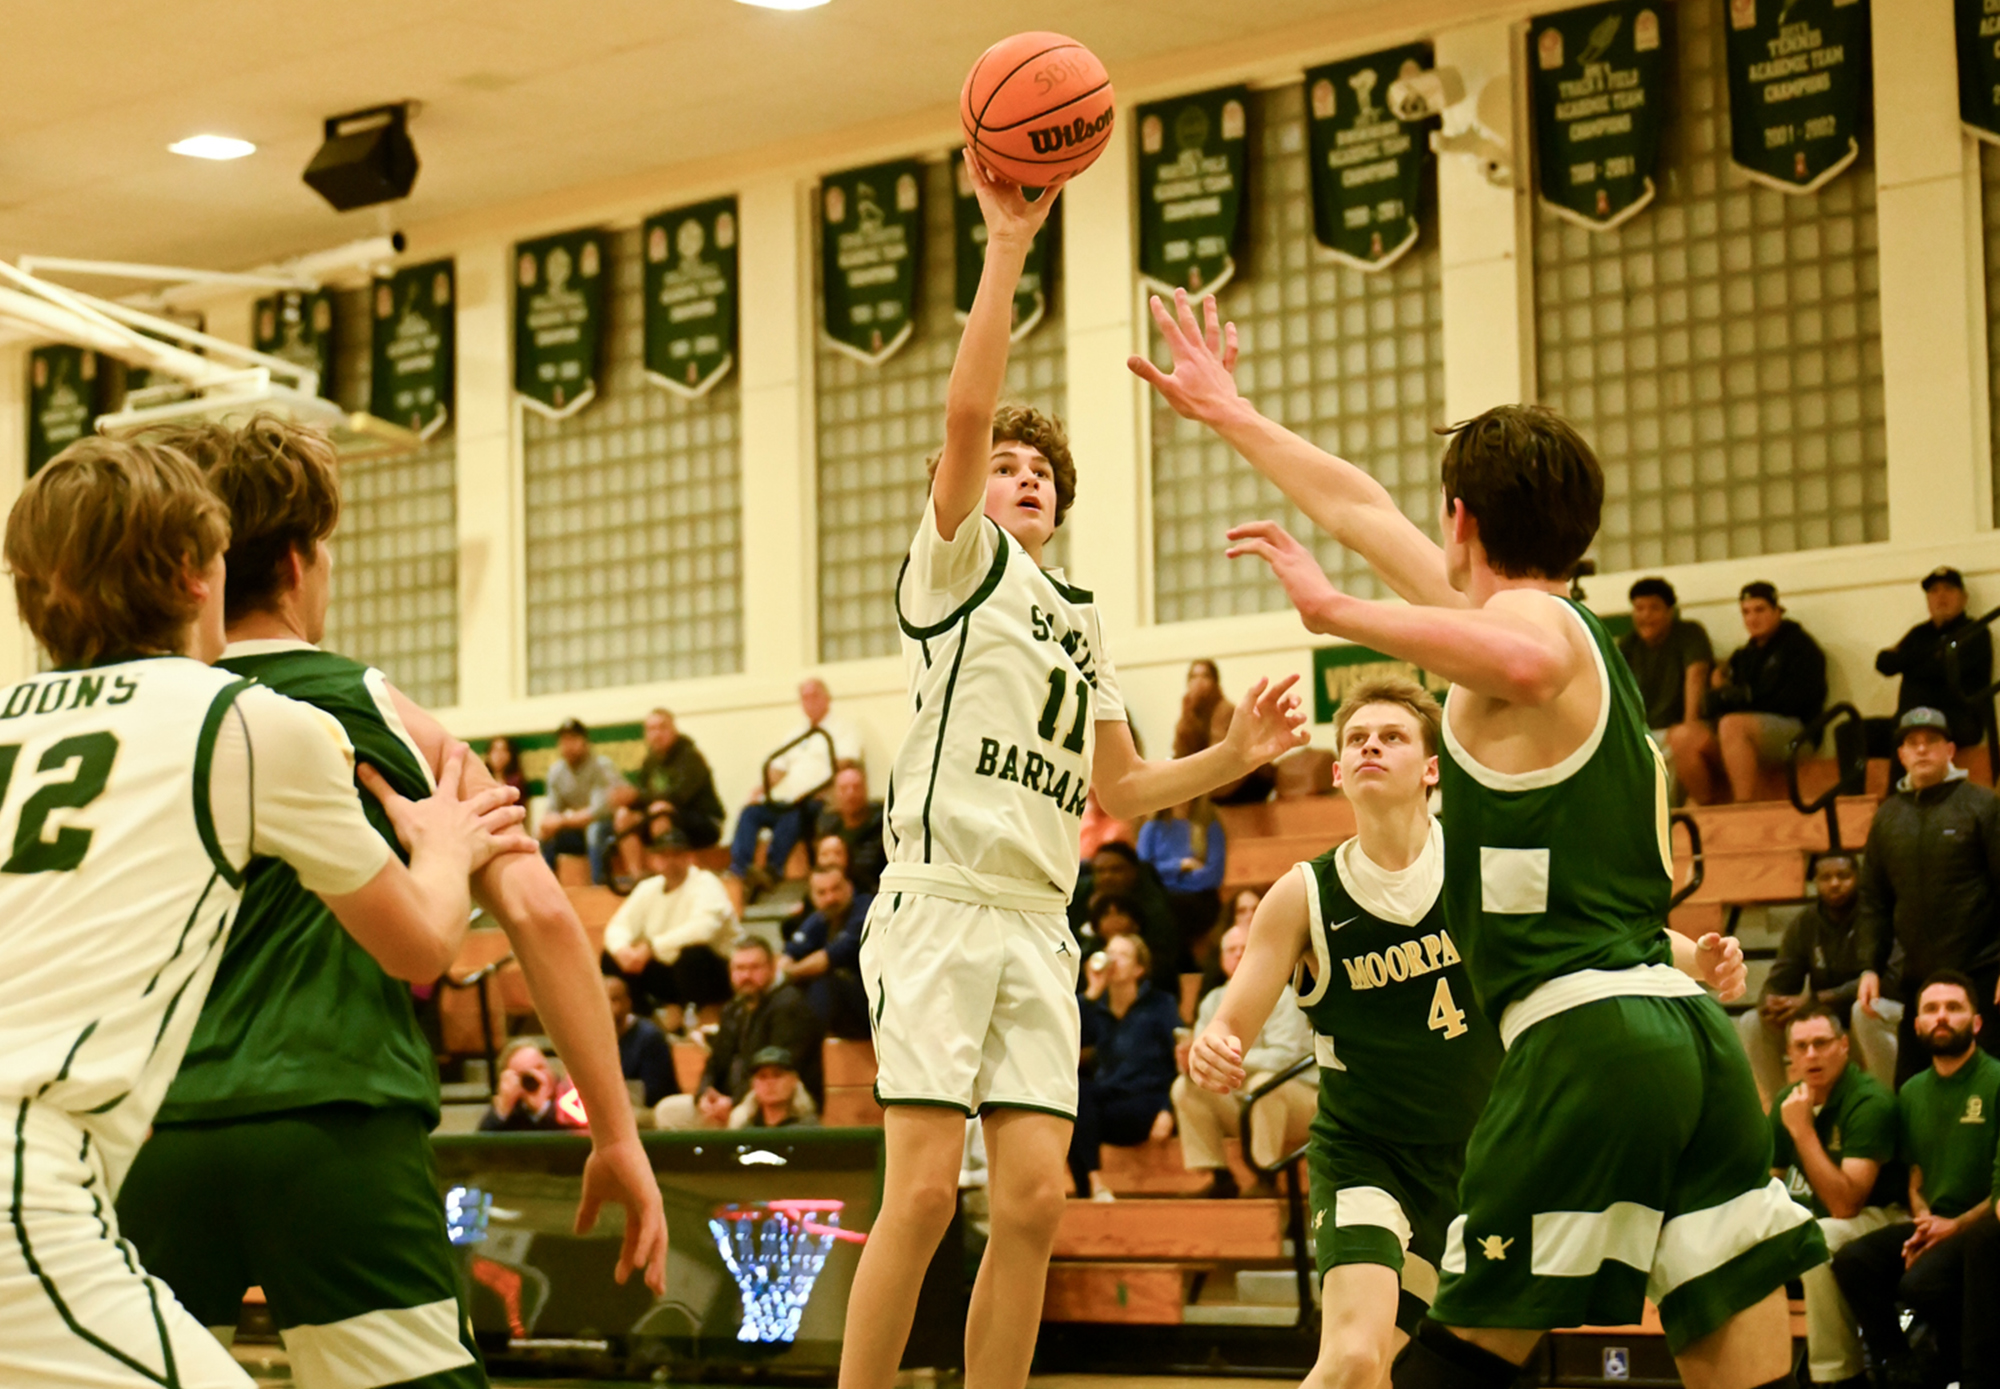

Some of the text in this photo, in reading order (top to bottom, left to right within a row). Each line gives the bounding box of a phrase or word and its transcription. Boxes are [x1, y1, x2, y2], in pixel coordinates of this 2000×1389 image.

[1027, 105, 1115, 155] Wilson
[0, 674, 138, 721] DONS
[1037, 666, 1089, 755] 11
[1342, 929, 1462, 990] MOORPA
[1427, 976, 1468, 1040] 4
